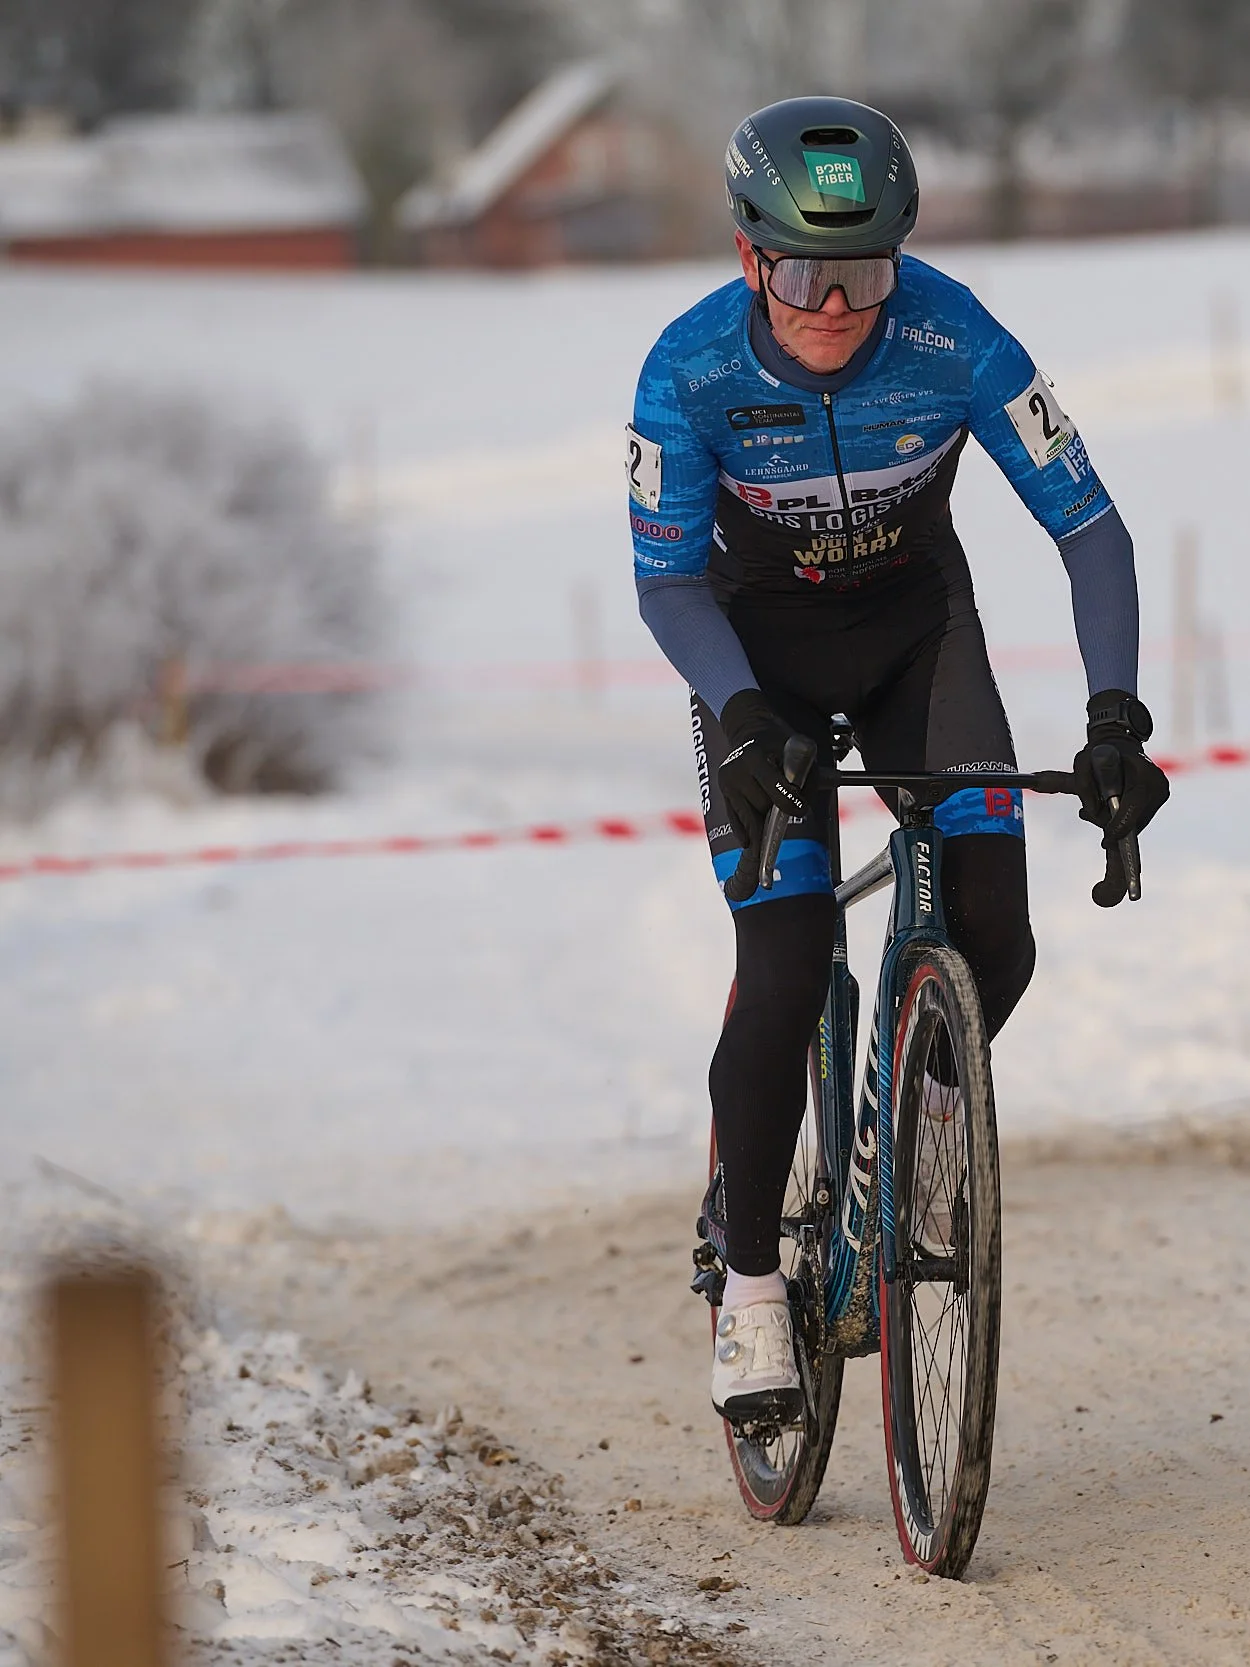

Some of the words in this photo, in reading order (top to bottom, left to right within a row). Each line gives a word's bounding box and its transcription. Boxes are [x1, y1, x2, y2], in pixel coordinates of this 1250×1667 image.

[752, 140, 780, 186] OPTICS
[815, 162, 852, 175] BORN
[817, 172, 854, 186] FIBER
[901, 326, 955, 351] FALCON
[913, 344, 937, 355] HOTEL
[688, 359, 742, 392] BASICO
[1029, 392, 1060, 440] 2
[629, 440, 642, 488] 2
[745, 463, 809, 476] LEHNSGAARD
[777, 495, 831, 511] PL
[810, 468, 936, 531] LOGISTICS
[793, 525, 903, 566] WORRY
[775, 781, 788, 796] VAN
[916, 841, 932, 912] FACTOR
